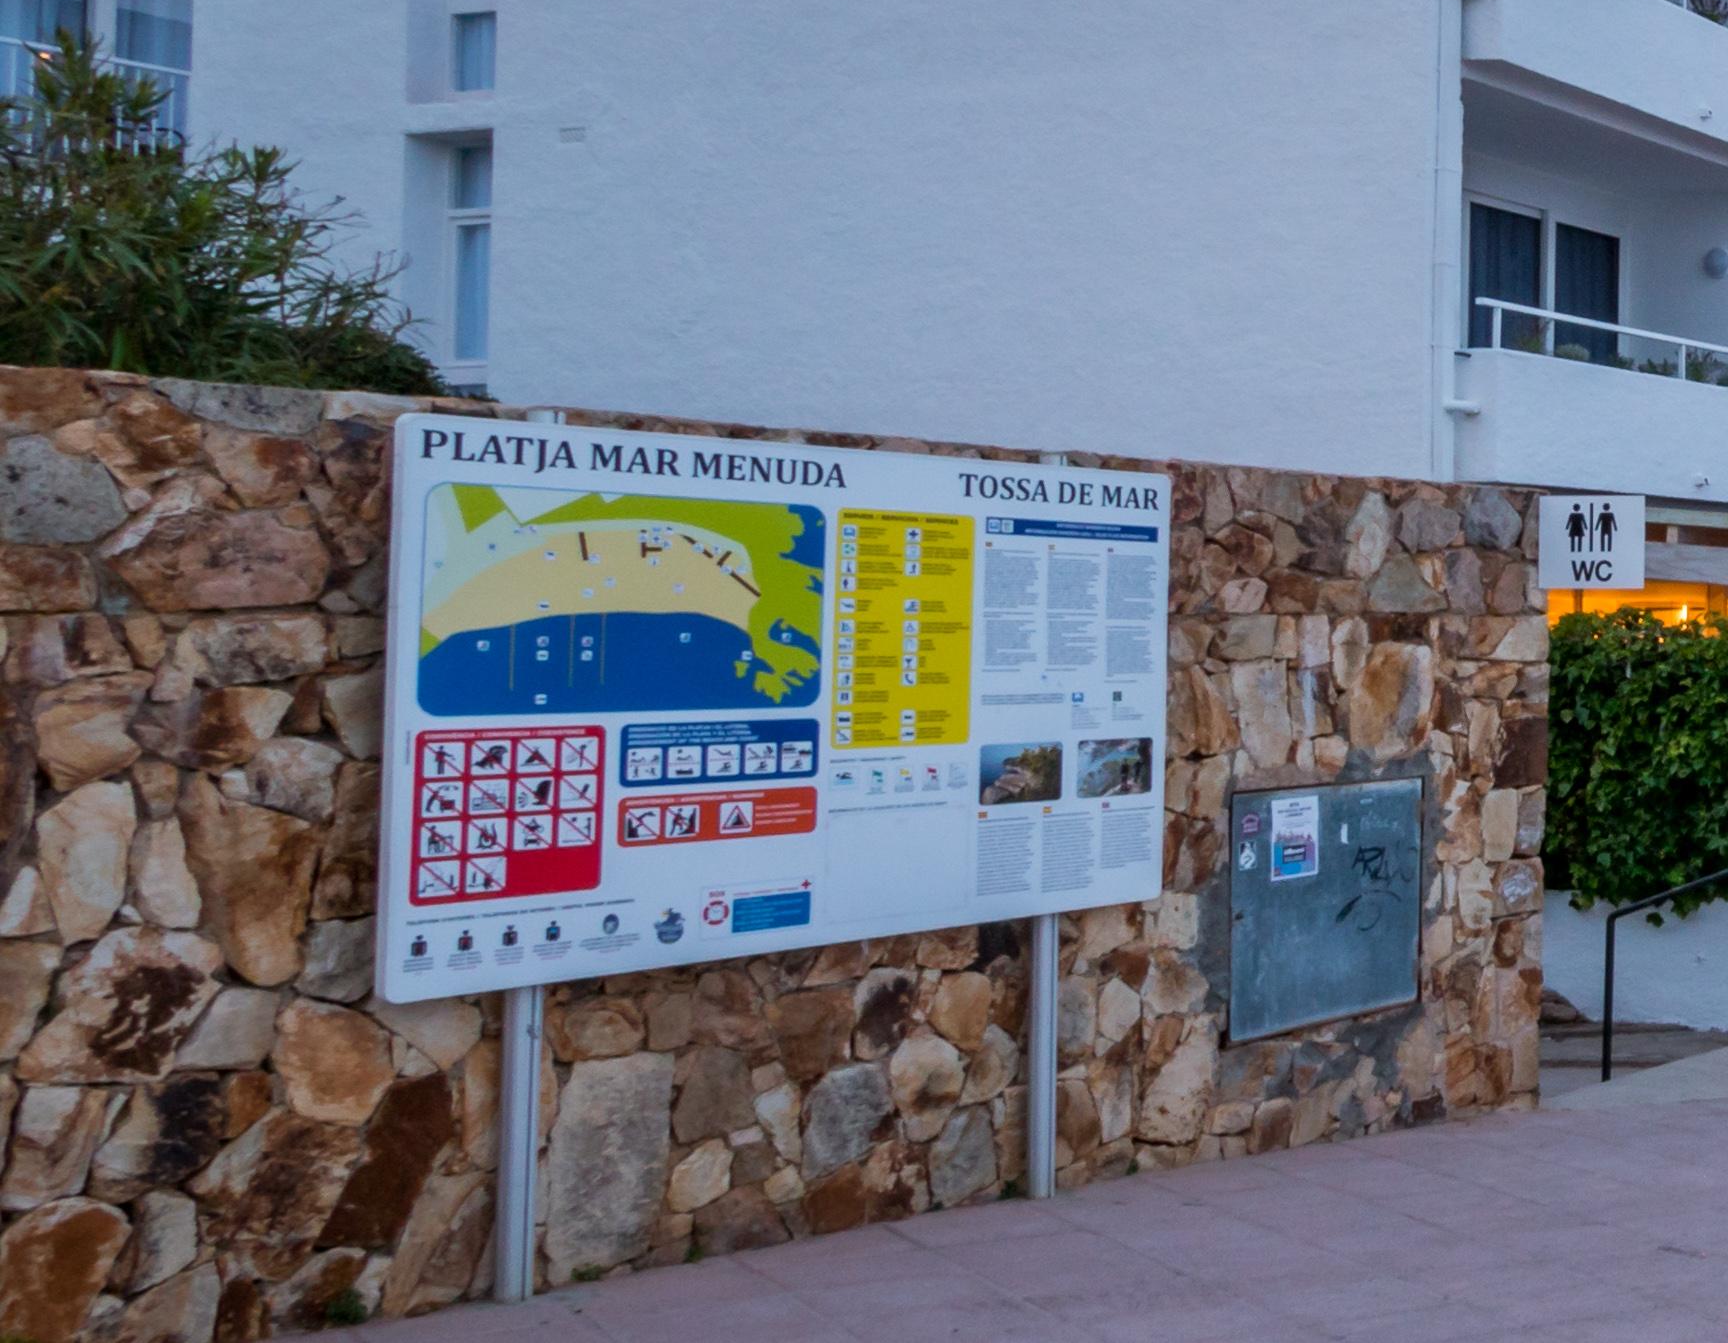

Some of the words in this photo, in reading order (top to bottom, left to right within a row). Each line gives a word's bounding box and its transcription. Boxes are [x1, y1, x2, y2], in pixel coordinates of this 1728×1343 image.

[421, 428, 578, 474] PLATJA
[589, 442, 681, 477] MAR
[692, 451, 848, 489] MENUDA
[959, 472, 1050, 503] TOSSA
[1058, 480, 1094, 506] DE
[1101, 484, 1160, 511] MAR
[1571, 559, 1613, 582] WC
